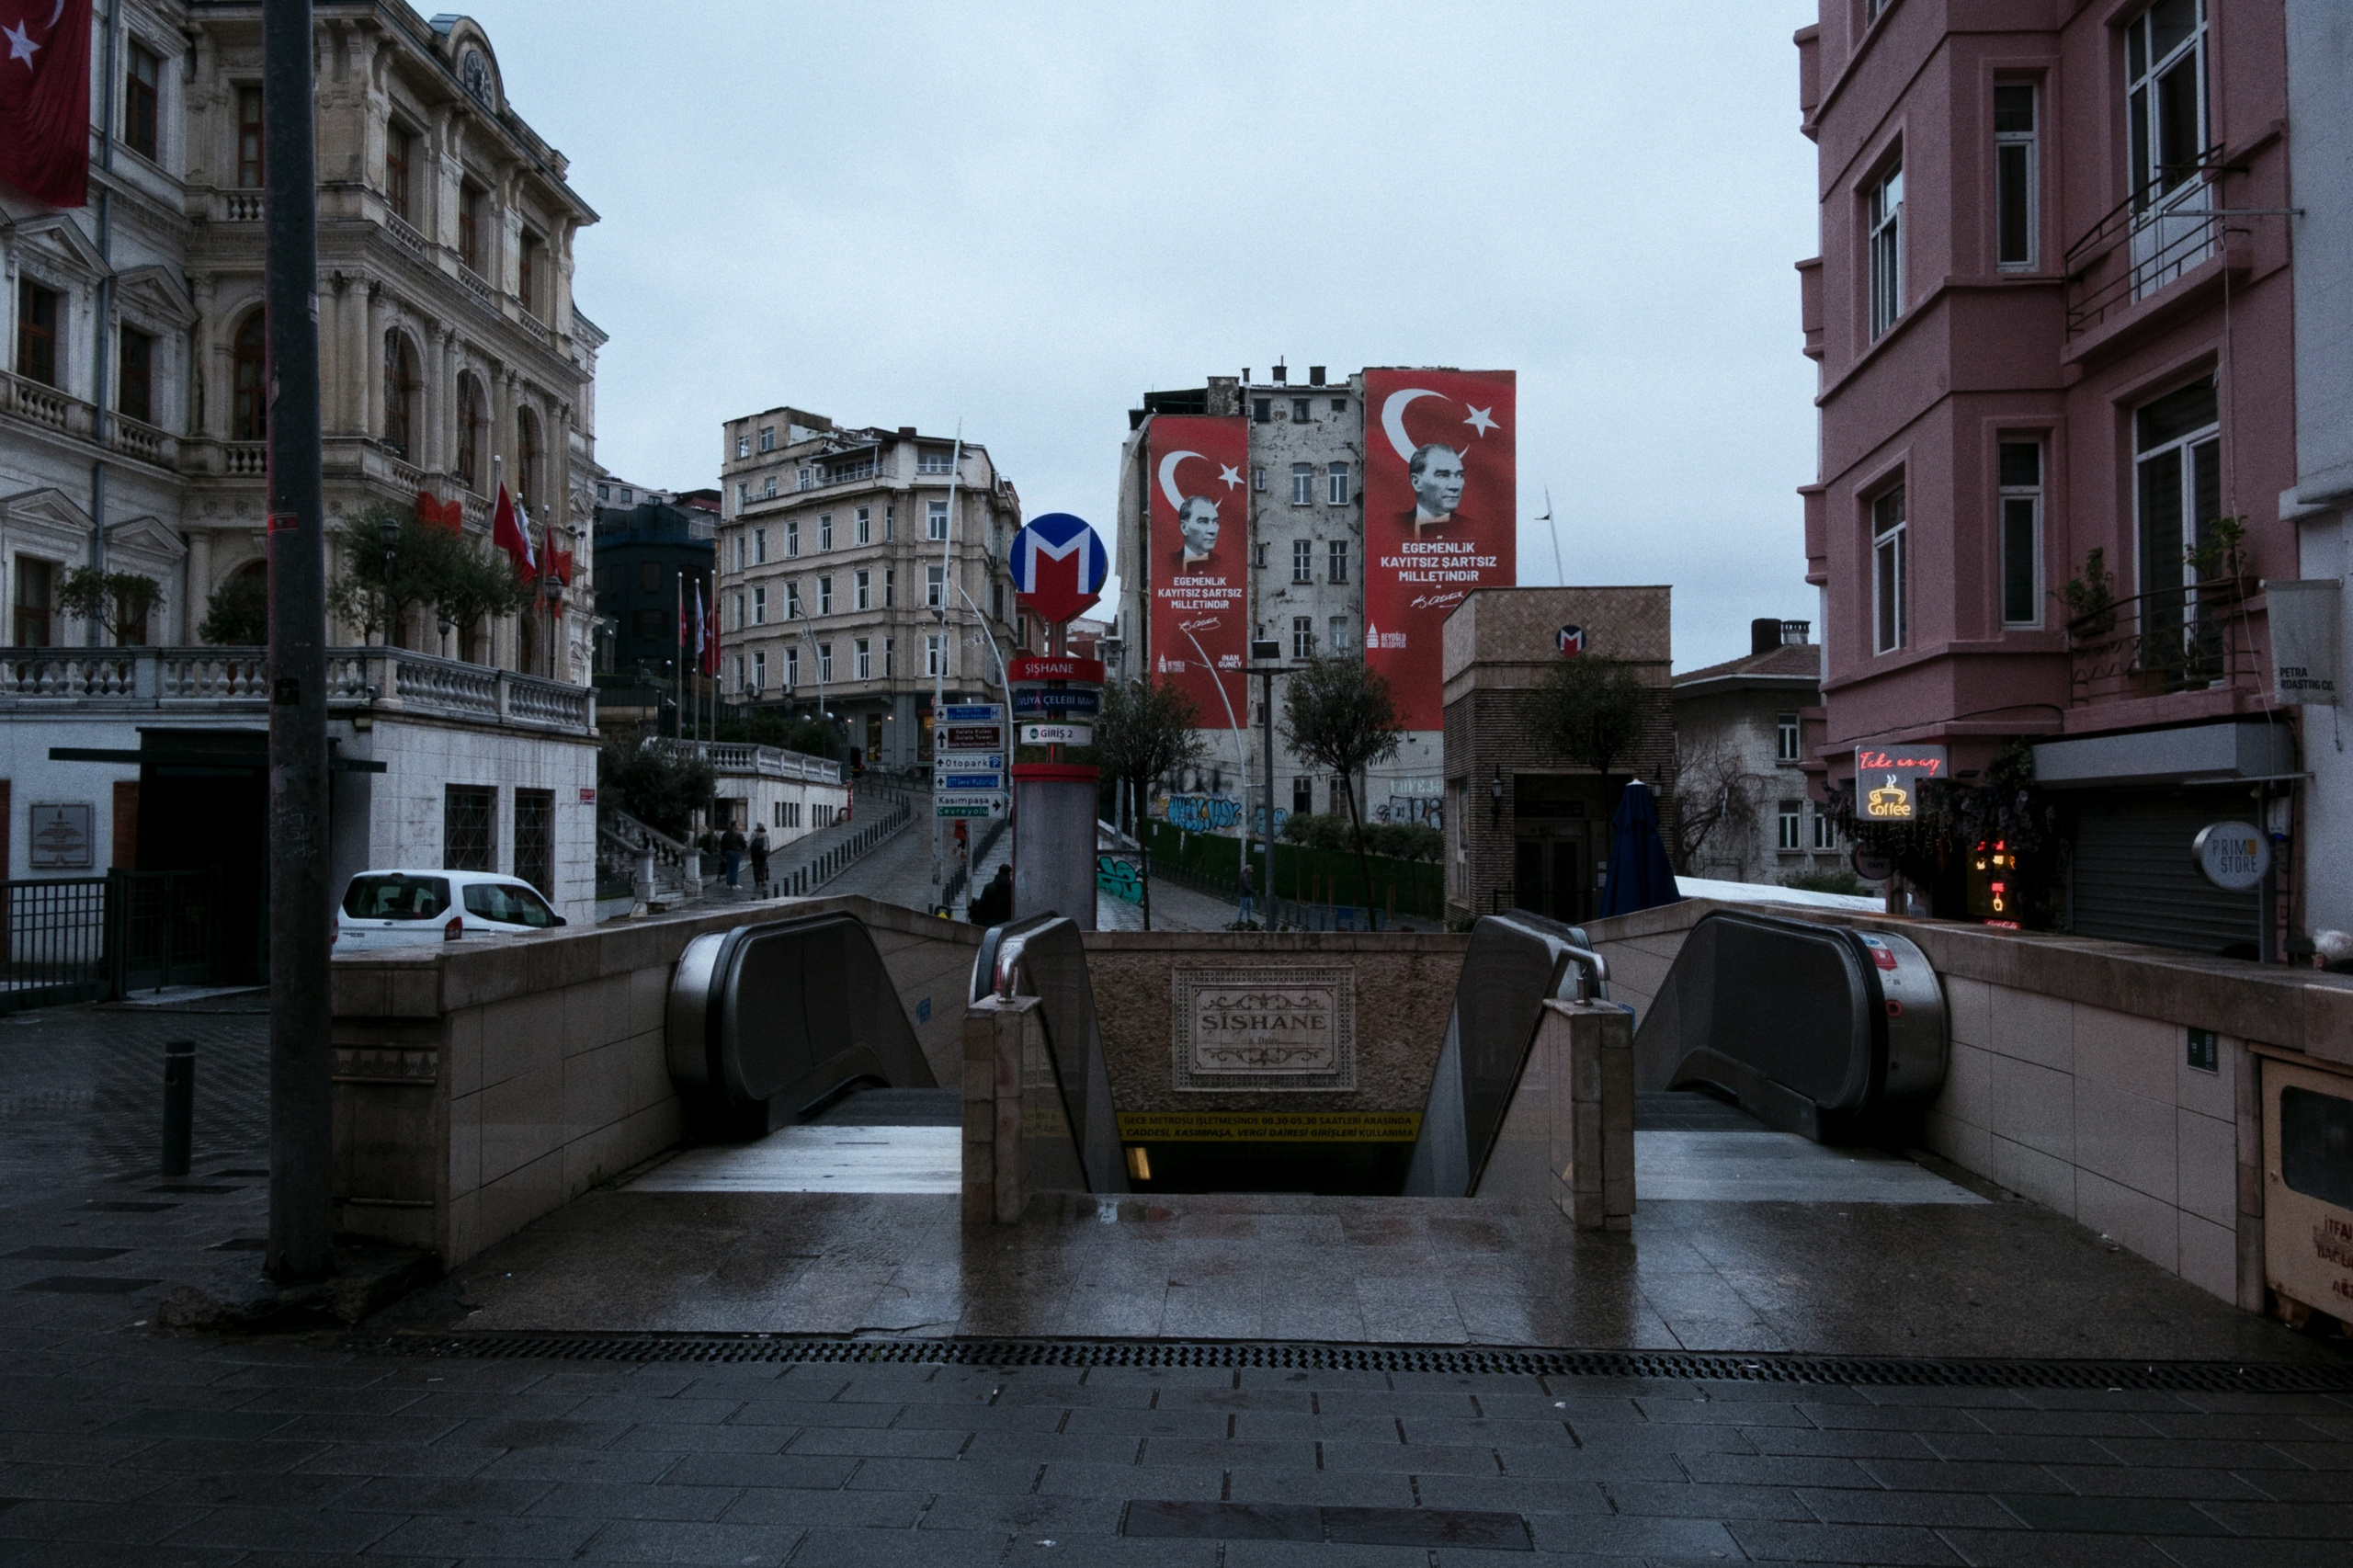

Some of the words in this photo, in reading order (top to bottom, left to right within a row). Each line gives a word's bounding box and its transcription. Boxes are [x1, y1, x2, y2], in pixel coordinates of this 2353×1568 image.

[1402, 542, 1475, 553] EGEMENLİK
[1381, 556, 1439, 568] KAYITSIZ
[1441, 556, 1497, 569] ŞARTSIZ
[1173, 576, 1227, 586] EGEMENLİK
[1398, 570, 1480, 582] MİLLETİNDİR
[1157, 588, 1200, 597] KAYITSIZ
[1201, 588, 1243, 598] ŞARTSIZ
[1170, 599, 1230, 609] MİLLETİNDİR
[1025, 662, 1074, 676] ŞİŞHANE
[2279, 667, 2308, 677] PETRA
[2280, 679, 2321, 690] ROASTING
[1043, 693, 1075, 707] ÇELEBİ
[1040, 727, 1065, 740] GİRİŞ
[1067, 730, 1073, 738] 2
[946, 758, 988, 768] Otopark
[1859, 751, 1893, 770] Take
[1896, 758, 1941, 777] away
[938, 796, 989, 805] Kasımpaşa
[938, 807, 988, 815] Çevreyolu
[1868, 802, 1911, 816] Coffee
[2221, 856, 2257, 873] STORE
[1201, 1012, 1327, 1034] ŞİŞHANE
[1124, 1116, 1146, 1125] GECE
[1149, 1116, 1193, 1125] METROSU
[1196, 1115, 1258, 1126] İŞLETMESİNDE
[1261, 1117, 1317, 1125] 00.30-05.30
[1320, 1116, 1361, 1125] SAATLERİ
[1364, 1117, 1412, 1125] ARASINDA
[1126, 1128, 1171, 1138] CADDESİ,
[1175, 1129, 1234, 1138] KASIMPAŞA,
[1237, 1128, 1267, 1137] VERGİ
[1269, 1128, 1308, 1137] DAİRESİ
[1311, 1128, 1357, 1138] GİRİŞLERİ
[1359, 1129, 1414, 1137] KULLANIMA
